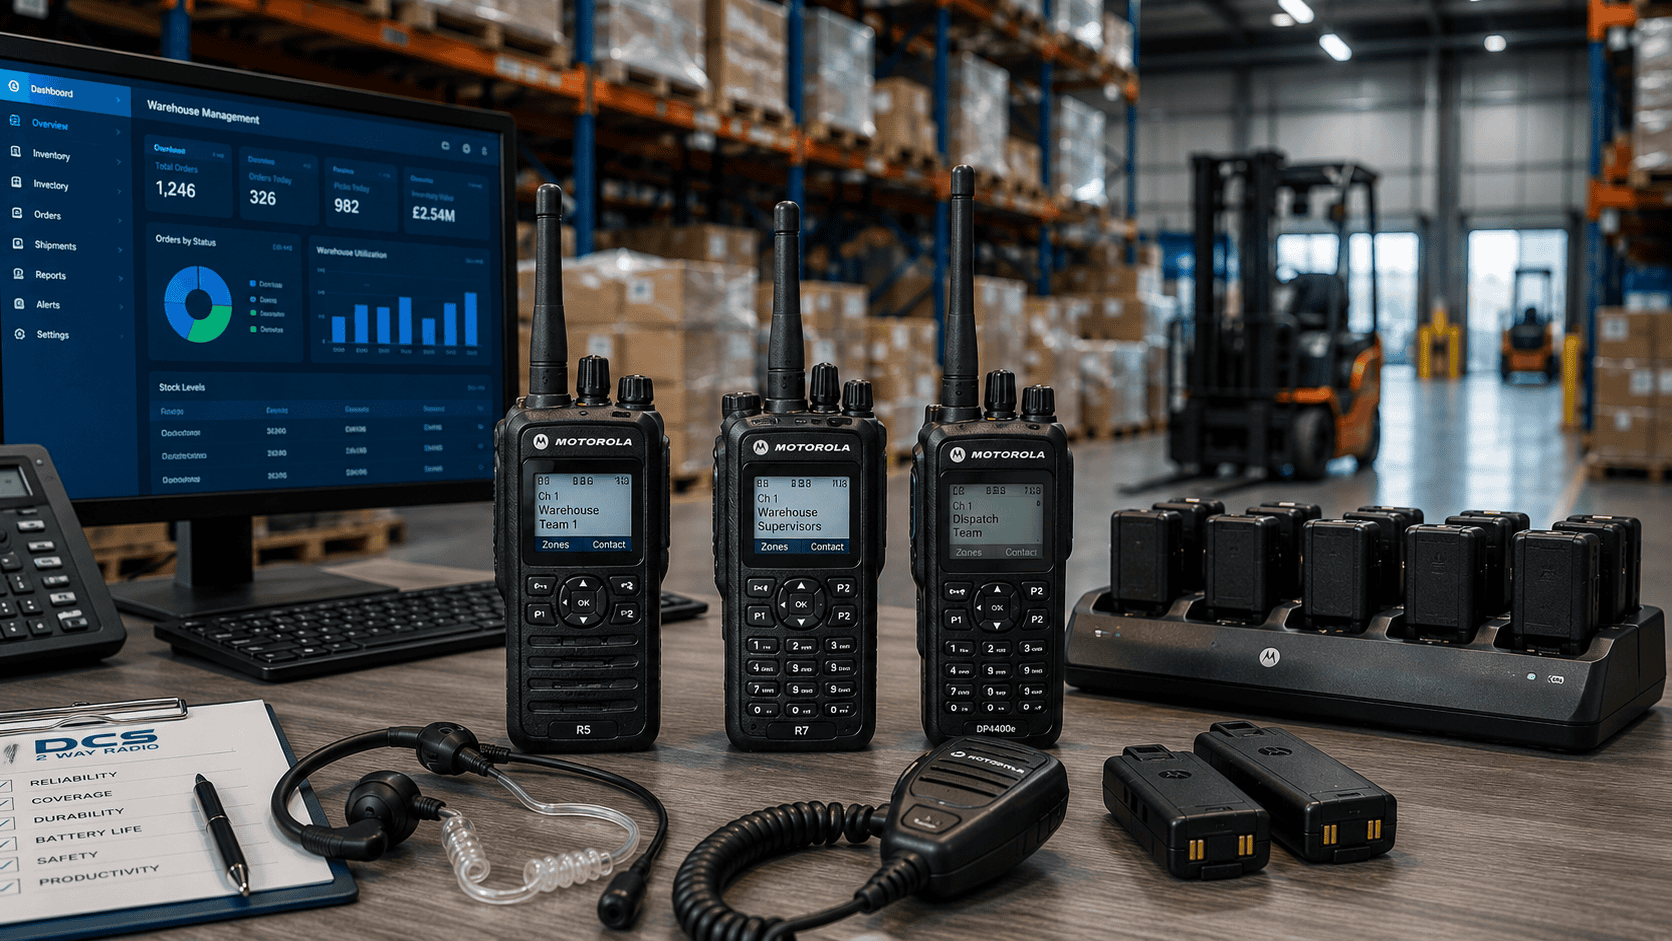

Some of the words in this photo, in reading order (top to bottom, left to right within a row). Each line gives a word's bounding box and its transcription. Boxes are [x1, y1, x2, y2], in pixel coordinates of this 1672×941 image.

[31, 84, 74, 98] Dashboard
[147, 100, 200, 118] Warehouse
[202, 107, 260, 126] Management
[32, 118, 68, 131] Overview
[33, 149, 70, 162] Inventory
[155, 162, 174, 171] Total
[175, 163, 198, 174] Orders
[156, 180, 196, 198] 1,246
[250, 189, 277, 206] 326
[334, 198, 360, 214] 982
[34, 210, 62, 221] Orders
[412, 206, 456, 222] £2.54M
[155, 234, 181, 245] Orders
[183, 236, 192, 247] by
[193, 237, 216, 248] Status
[34, 240, 77, 254] Shipments
[316, 246, 354, 258] Warehouse
[36, 270, 66, 282] Reports
[36, 300, 60, 310] Alerts
[37, 330, 70, 341] Settings
[158, 382, 180, 392] Stock
[182, 383, 206, 392] Levels
[555, 438, 632, 446] MOTOROLA
[775, 443, 850, 452] MOTOROLA
[971, 450, 1046, 459] MOTOROLA
[538, 492, 550, 501] Ch
[554, 492, 559, 500] 1
[758, 494, 770, 503] Ch
[774, 494, 778, 503] 1
[538, 505, 600, 515] Warehouse
[953, 502, 965, 510] Ch
[968, 502, 972, 510] 1
[758, 507, 818, 517] Warehouse
[540, 519, 569, 530] Team
[572, 519, 578, 529] 1
[758, 521, 822, 533] Supervisors
[954, 528, 982, 538] Team
[542, 540, 570, 549] Zones
[592, 540, 626, 549] Contact
[761, 542, 788, 551] Zones
[810, 542, 844, 551] Contact
[956, 548, 982, 557] Zones
[837, 583, 850, 592] P2
[1030, 587, 1043, 595] P2
[534, 610, 545, 618] P1
[838, 612, 850, 620] P2
[1031, 616, 1043, 624] P2
[754, 641, 759, 650] 1
[793, 642, 799, 650] 2
[1024, 644, 1030, 652] 3
[950, 667, 956, 675] 4
[754, 685, 760, 693] 7
[576, 725, 591, 735] R5
[794, 726, 809, 736] R7
[976, 724, 1016, 733] DP4400e
[34, 728, 158, 755] DCS
[55, 748, 97, 760] WAY
[104, 743, 160, 754] RADIO
[30, 771, 118, 787] RELIABILITY
[32, 790, 113, 805] COVERAGE
[34, 807, 125, 824] DURABILITY
[36, 828, 106, 844] BATTERY
[111, 825, 142, 835] LIFE
[37, 850, 98, 865] SAFETY
[39, 864, 160, 886] PRODUCTIVITY
